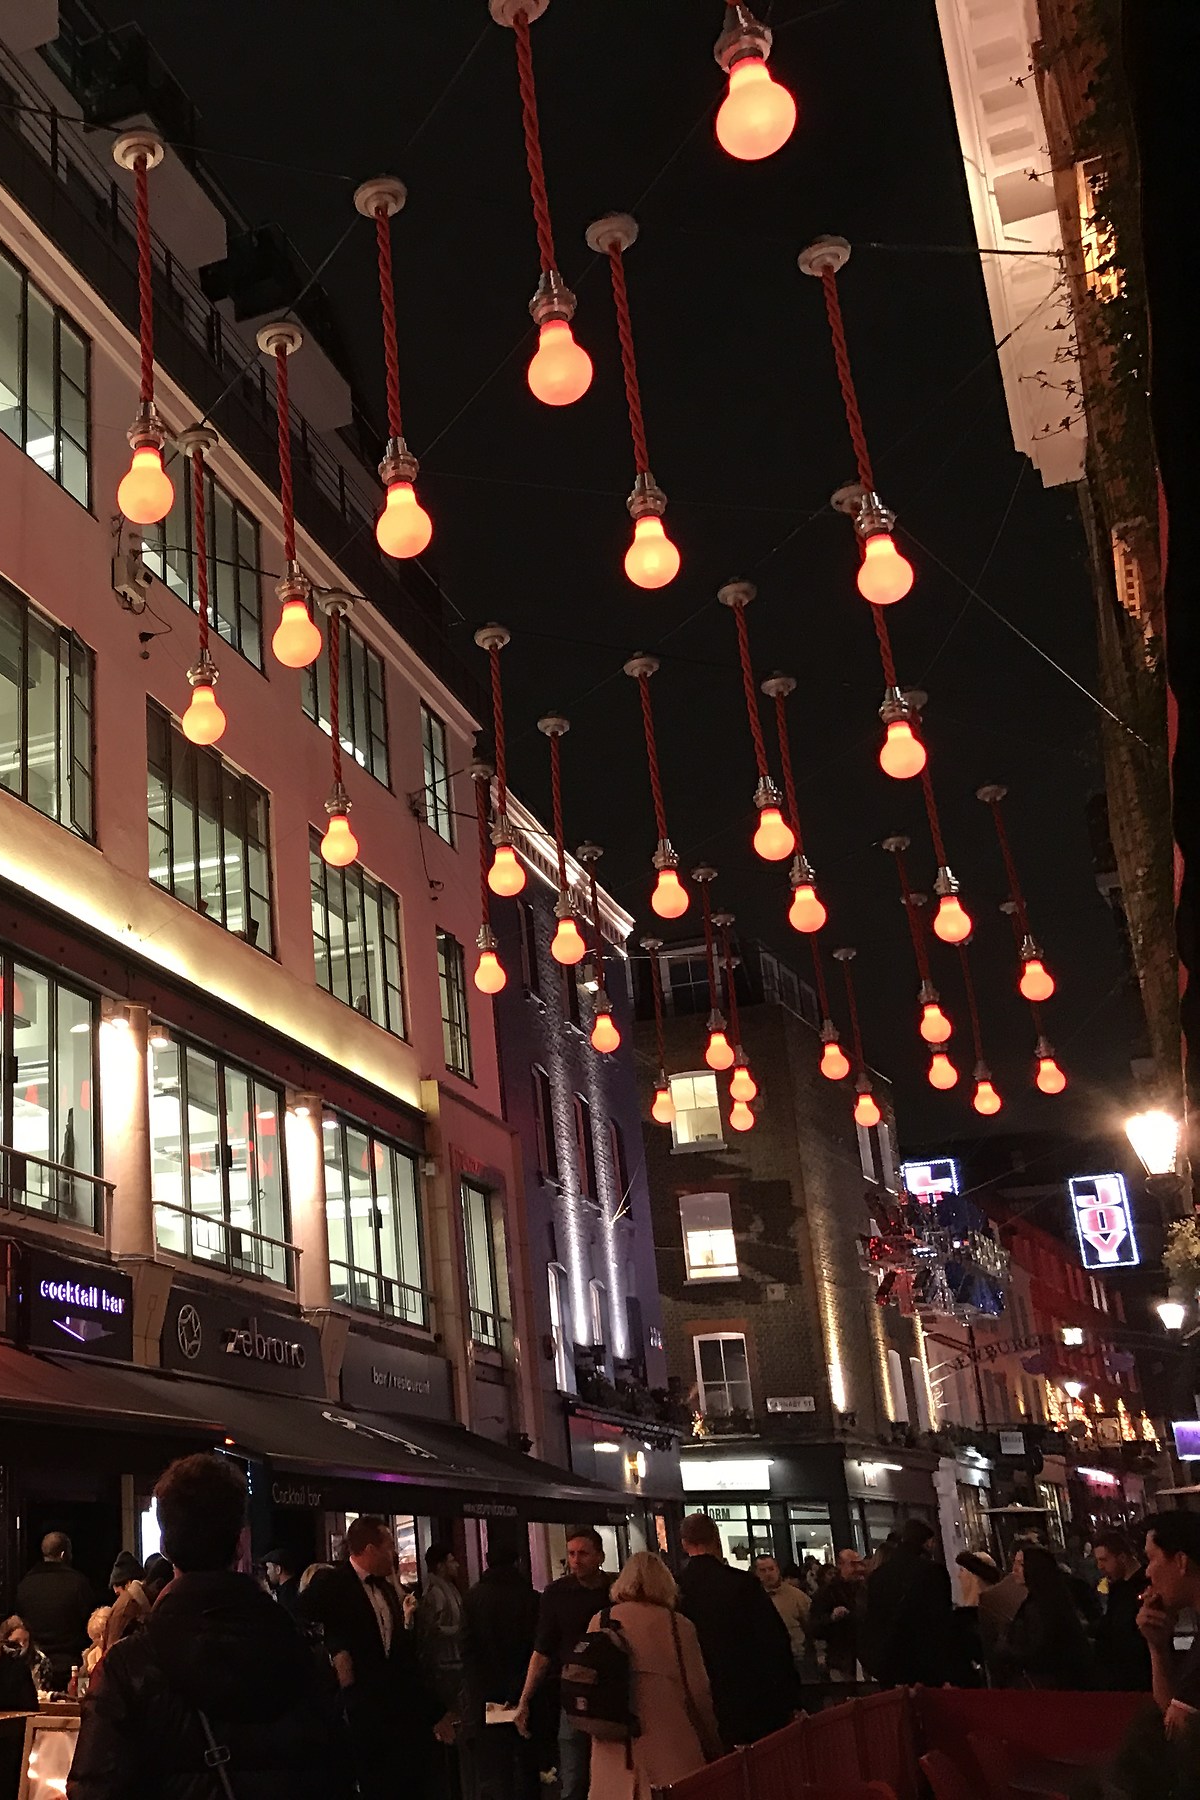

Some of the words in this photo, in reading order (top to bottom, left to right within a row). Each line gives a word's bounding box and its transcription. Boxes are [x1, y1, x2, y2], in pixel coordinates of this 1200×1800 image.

[1075, 1178, 1127, 1262] JOY
[40, 1280, 98, 1309] cocktail
[102, 1289, 125, 1314] bar
